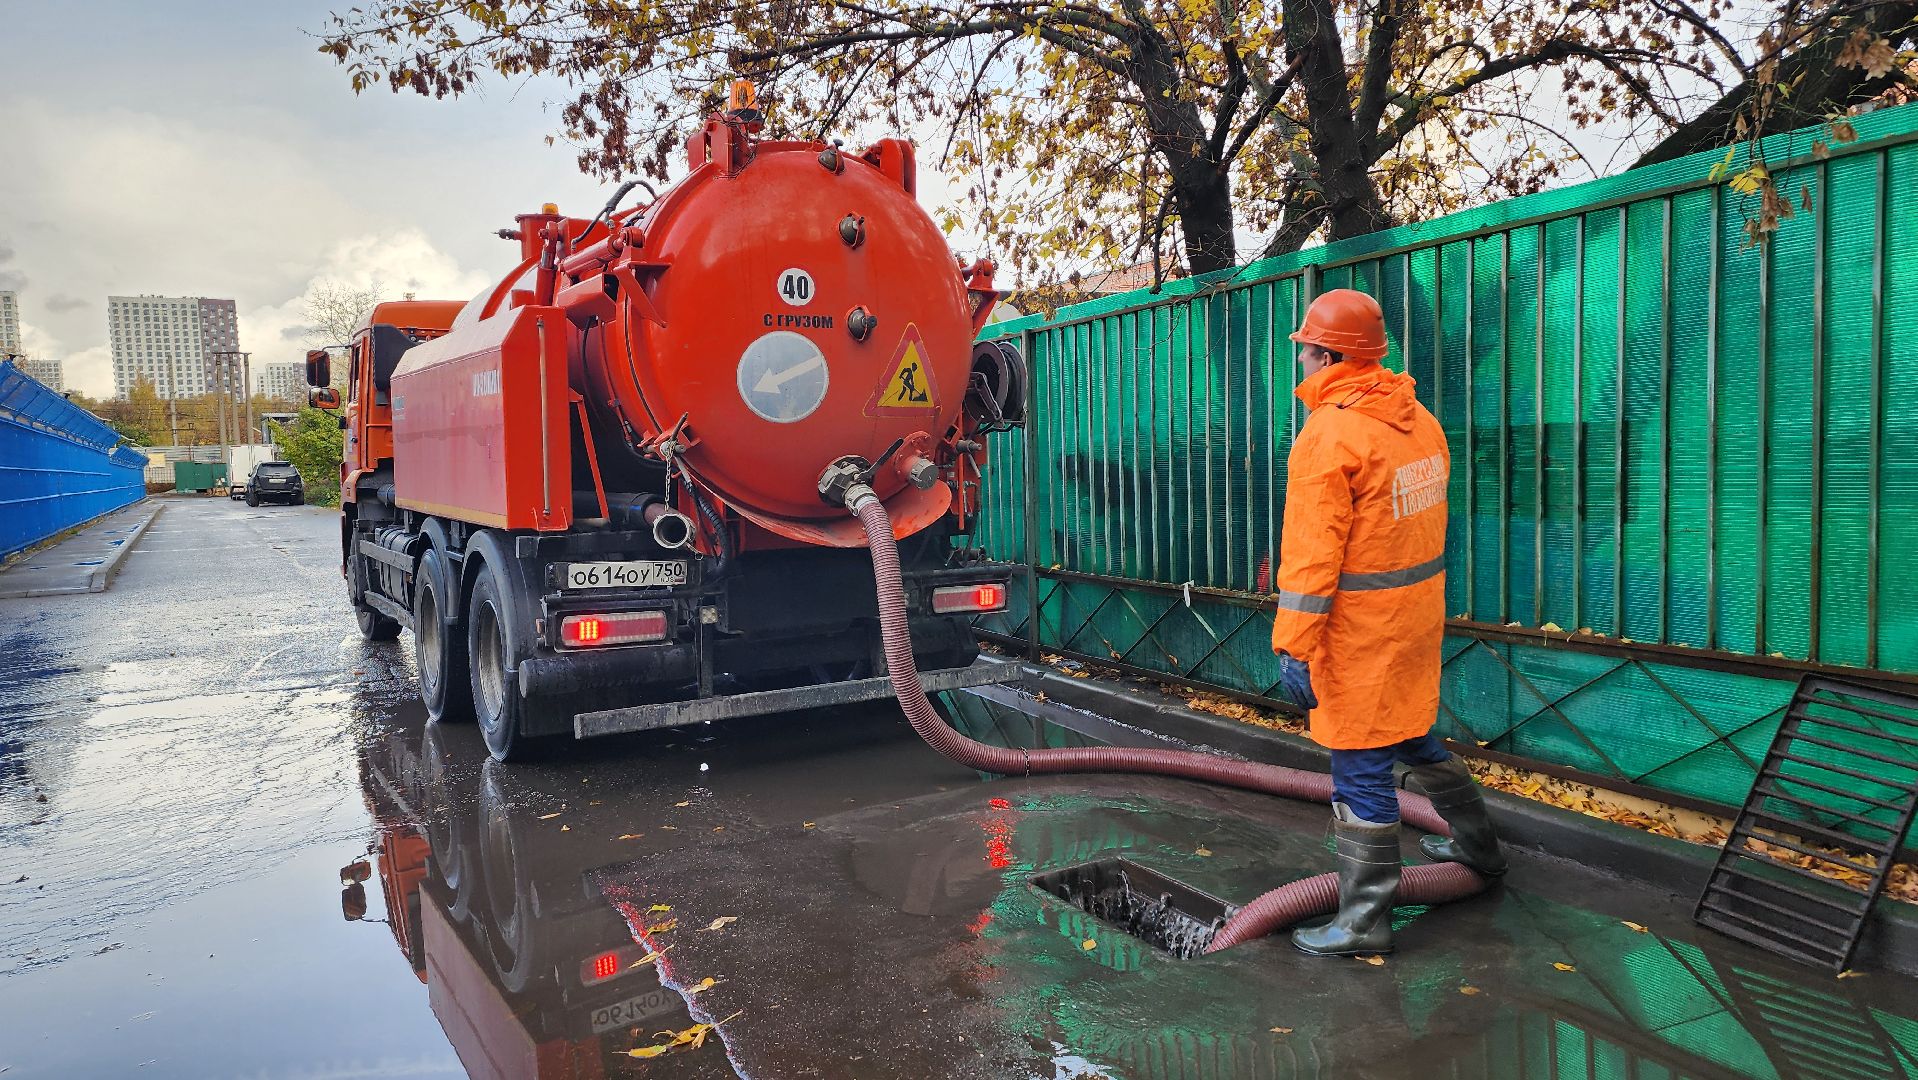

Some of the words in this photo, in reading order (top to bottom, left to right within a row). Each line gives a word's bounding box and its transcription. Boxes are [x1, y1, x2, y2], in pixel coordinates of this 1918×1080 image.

[783, 274, 809, 300] 40
[763, 313, 773, 327] С
[777, 314, 833, 329] ГРУЗОМ
[654, 562, 683, 578] 750
